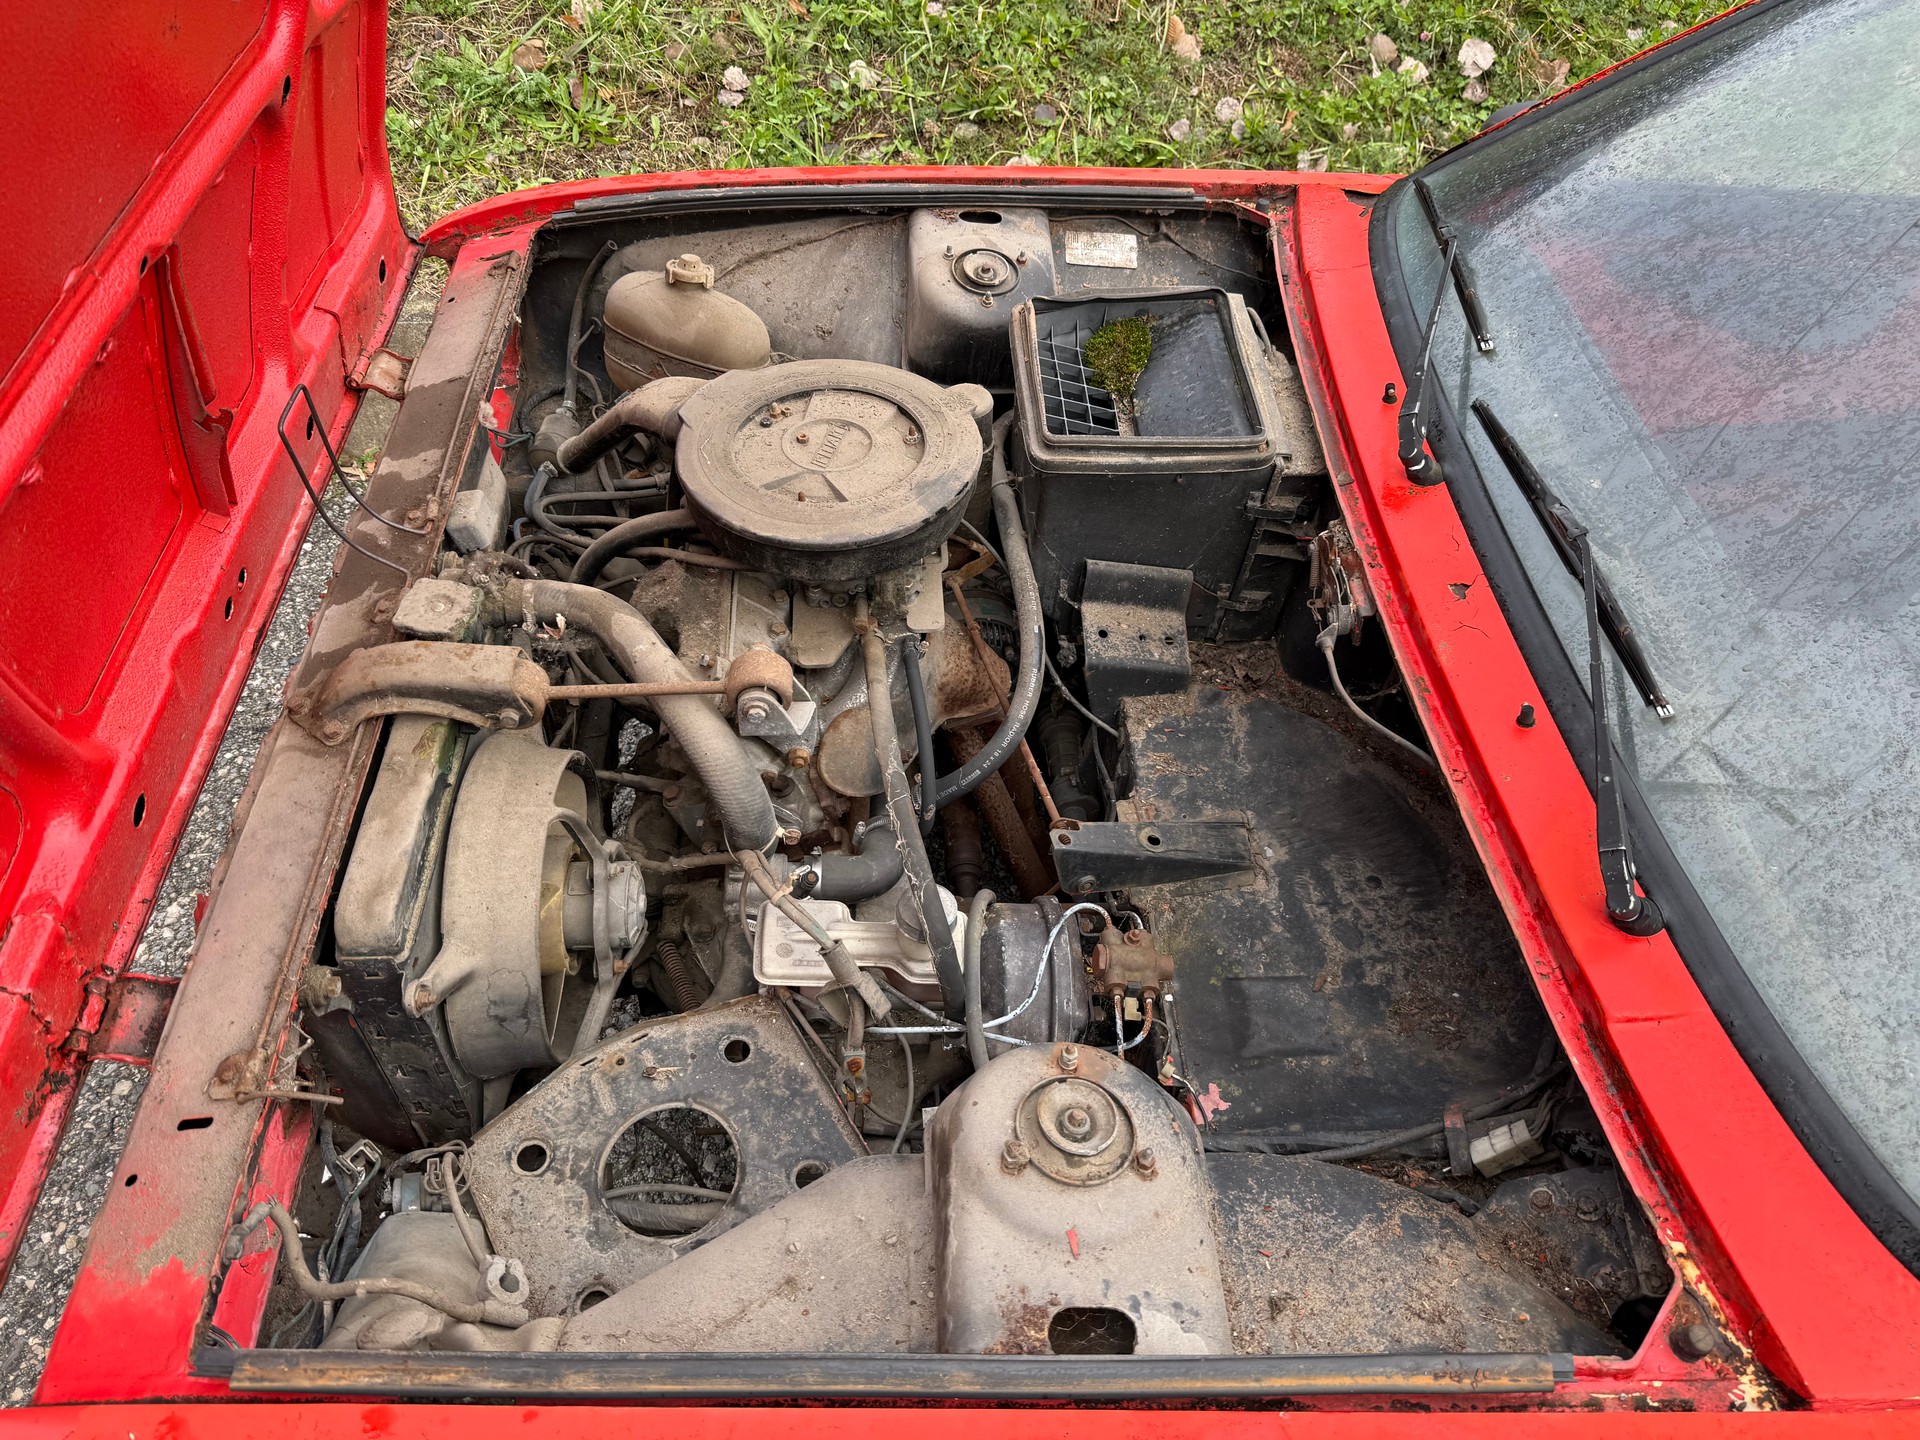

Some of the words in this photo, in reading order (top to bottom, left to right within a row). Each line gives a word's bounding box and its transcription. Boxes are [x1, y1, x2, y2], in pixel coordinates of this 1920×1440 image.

[1026, 668, 1038, 698] RUBBER
[1018, 700, 1030, 720] HOSE
[1001, 721, 1021, 748] RADIOR
[993, 749, 1002, 757] 18
[982, 760, 991, 768] 24
[940, 785, 958, 798] MADE
